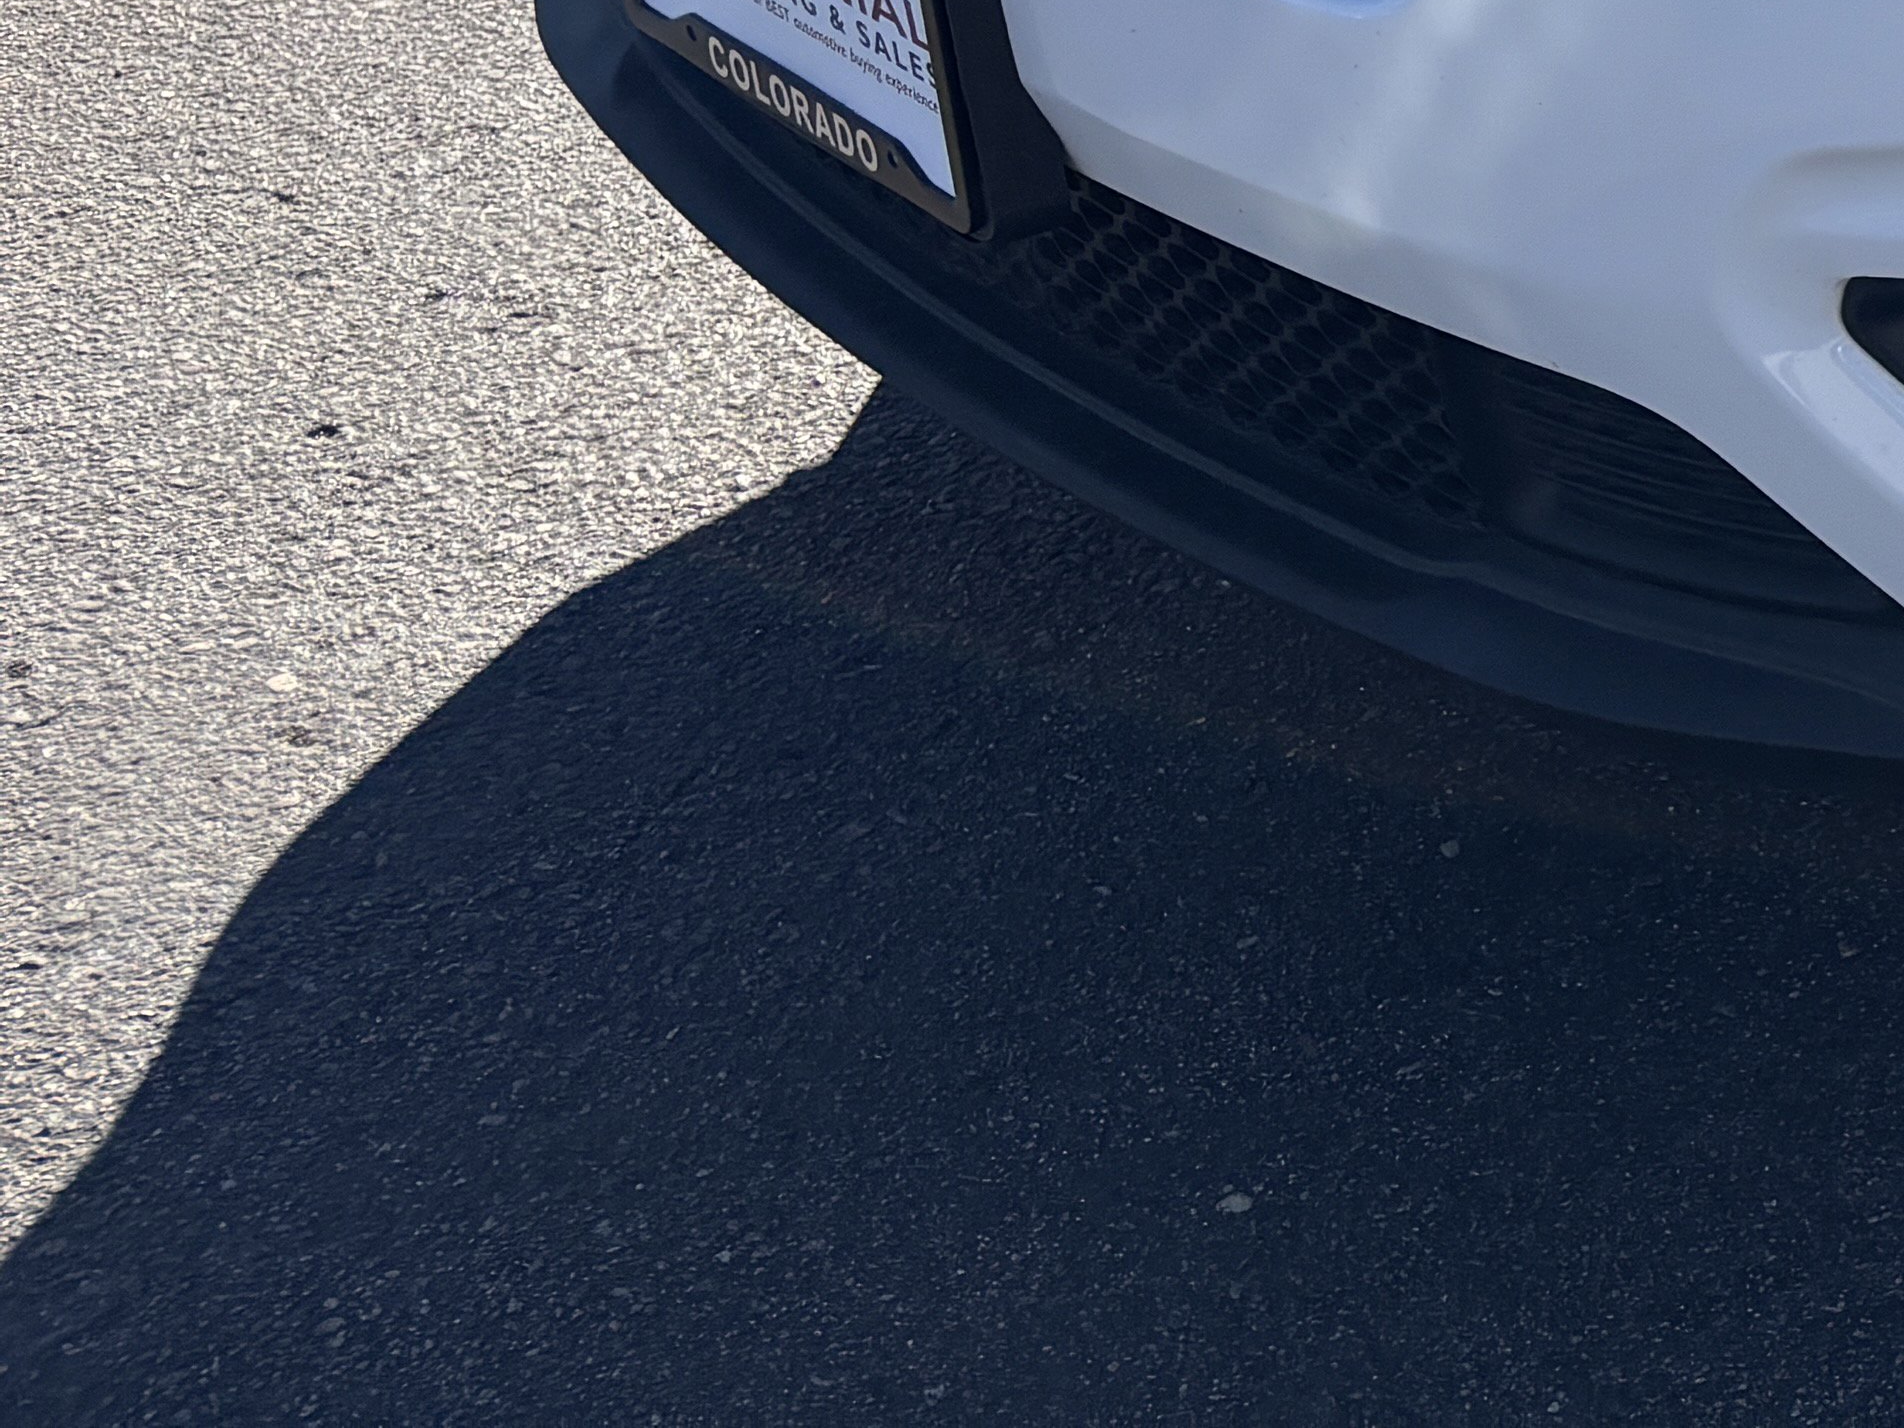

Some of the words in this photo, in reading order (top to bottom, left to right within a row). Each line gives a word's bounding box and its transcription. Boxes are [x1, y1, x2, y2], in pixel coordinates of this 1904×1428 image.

[829, 4, 846, 35] &
[849, 47, 882, 84] buying
[708, 36, 878, 172] COLORADO
